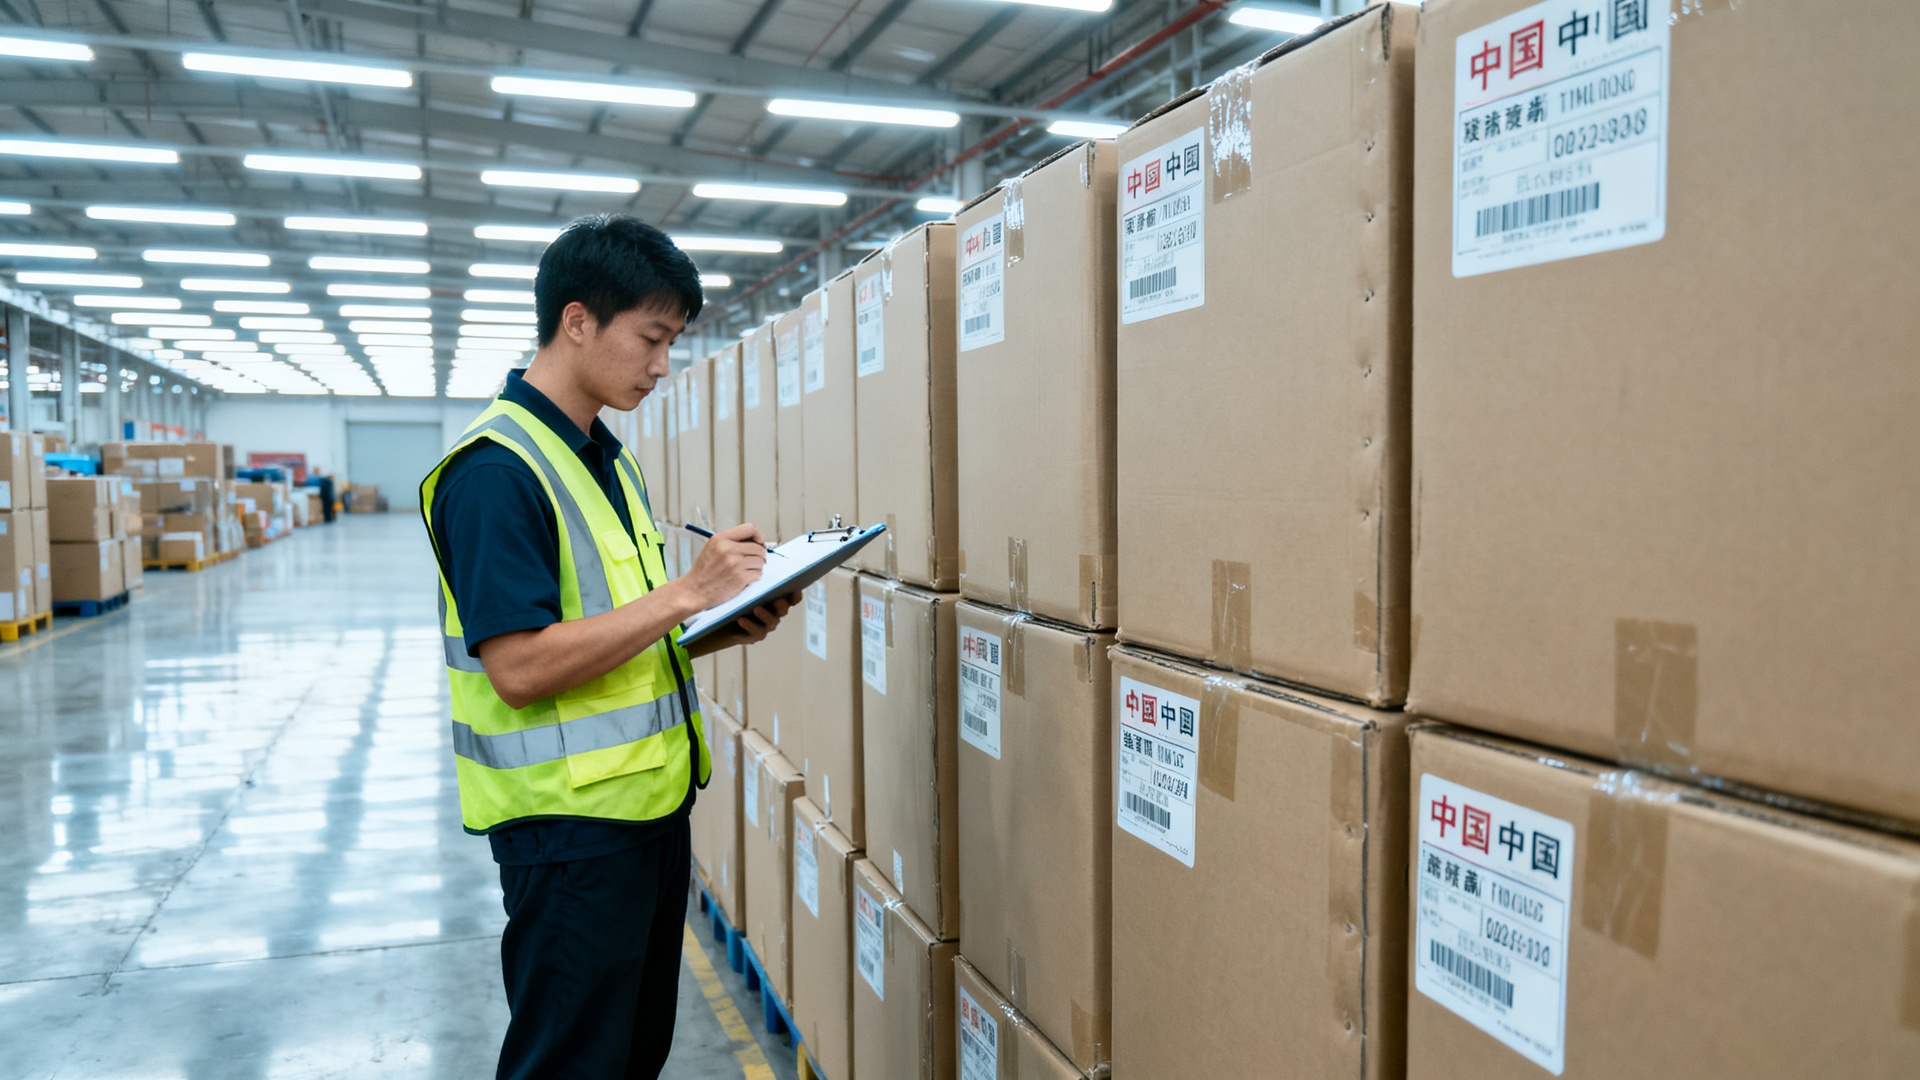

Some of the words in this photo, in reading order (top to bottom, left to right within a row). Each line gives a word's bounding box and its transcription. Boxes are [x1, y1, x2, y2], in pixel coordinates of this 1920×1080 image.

[1470, 19, 1544, 91] 中国
[1431, 795, 1491, 855] 中国
[1499, 821, 1561, 880] 中国
